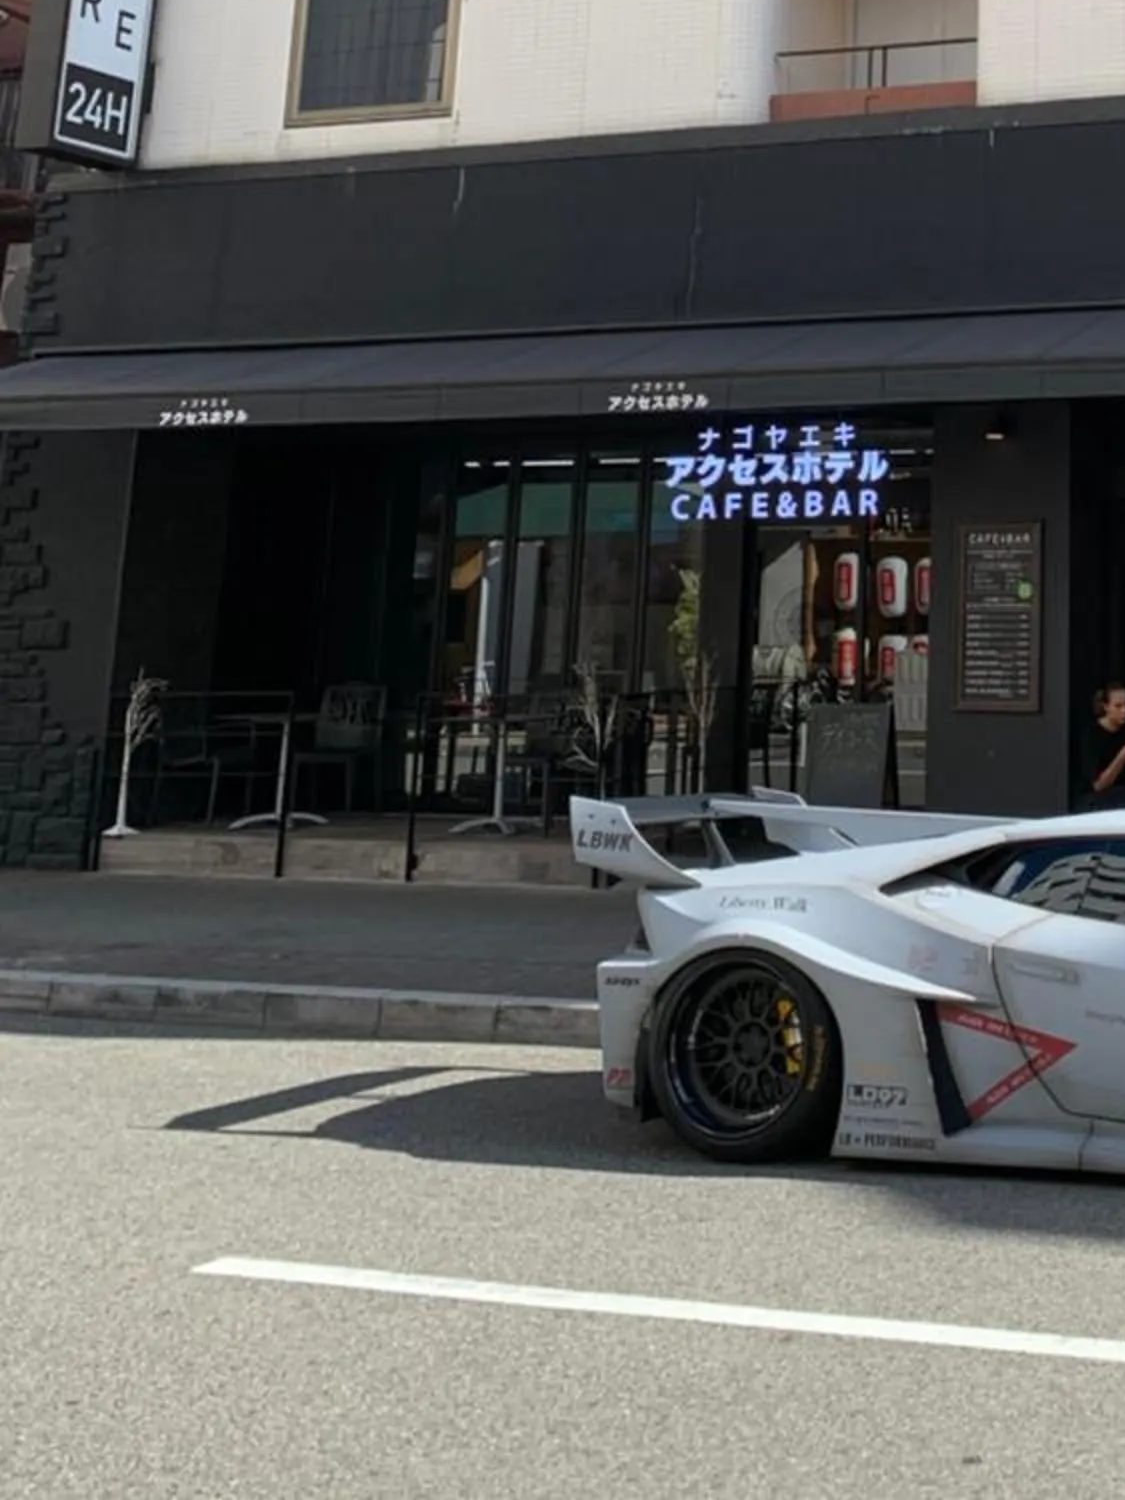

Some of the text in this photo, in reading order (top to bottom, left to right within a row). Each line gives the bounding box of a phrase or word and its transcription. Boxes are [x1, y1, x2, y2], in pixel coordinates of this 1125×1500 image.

[66, 82, 128, 136] 24H
[607, 394, 709, 411] アクセスホテル
[665, 450, 889, 488] アクセスホテル
[670, 489, 879, 520] CAFE&BAR
[576, 829, 633, 852] LBWK
